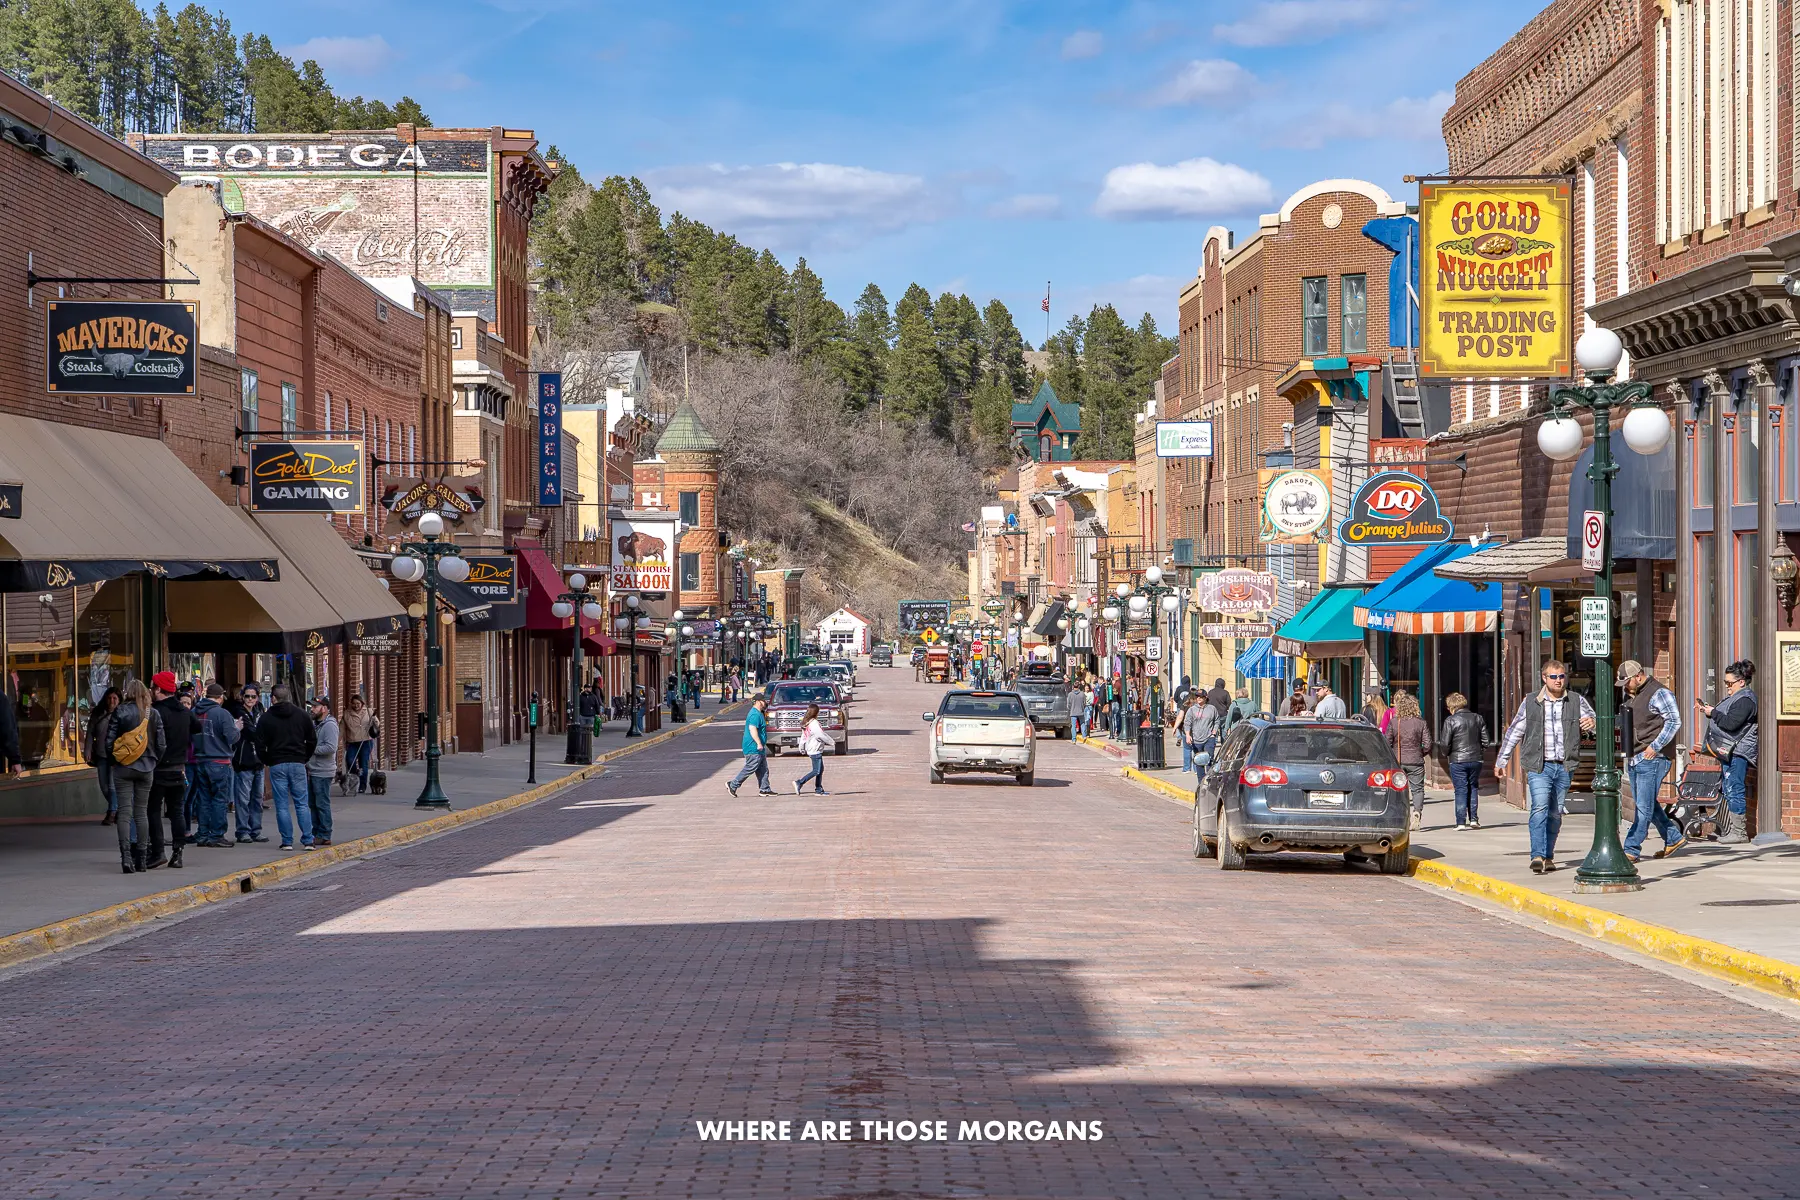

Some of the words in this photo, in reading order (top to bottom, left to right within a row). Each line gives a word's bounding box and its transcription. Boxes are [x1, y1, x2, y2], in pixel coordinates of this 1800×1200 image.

[183, 144, 428, 168] BODEGA
[1451, 200, 1540, 235] GOLD
[1436, 250, 1553, 292] NUGGET
[1438, 311, 1556, 334] TRADING
[57, 317, 188, 354] MAVERICKS
[1457, 335, 1532, 358] POST
[67, 361, 102, 372] Steaks
[134, 362, 179, 373] Cocktails
[543, 383, 557, 495] BODEGA
[1181, 435, 1207, 444] Express
[254, 451, 308, 477] Gold
[294, 452, 358, 478] Dust
[1284, 477, 1313, 487] DAKOTA
[263, 487, 350, 499] GAMING
[395, 483, 428, 512] JACOBS
[436, 484, 471, 512] GALLERY
[1375, 489, 1415, 510] DQ
[1281, 518, 1294, 527] SKY
[1294, 518, 1315, 528] STONE
[1349, 522, 1404, 541] Orange
[1403, 521, 1443, 538] Julius
[1584, 558, 1601, 567] PARKING
[470, 563, 513, 580] Dust
[613, 565, 672, 573] STEAKHOUSE
[613, 574, 671, 589] SALOON
[1203, 575, 1273, 586] GUNSLINGER
[469, 585, 509, 595] TORE
[1211, 600, 1264, 609] SALOON
[1586, 603, 1594, 611] 20
[1595, 603, 1604, 611] MIN
[1583, 613, 1606, 621] UNLOADING
[1589, 622, 1601, 631] ZONE
[1584, 633, 1591, 641] 24
[1592, 633, 1607, 641] HOURS
[1585, 642, 1595, 651] PER
[1596, 642, 1605, 651] DAY
